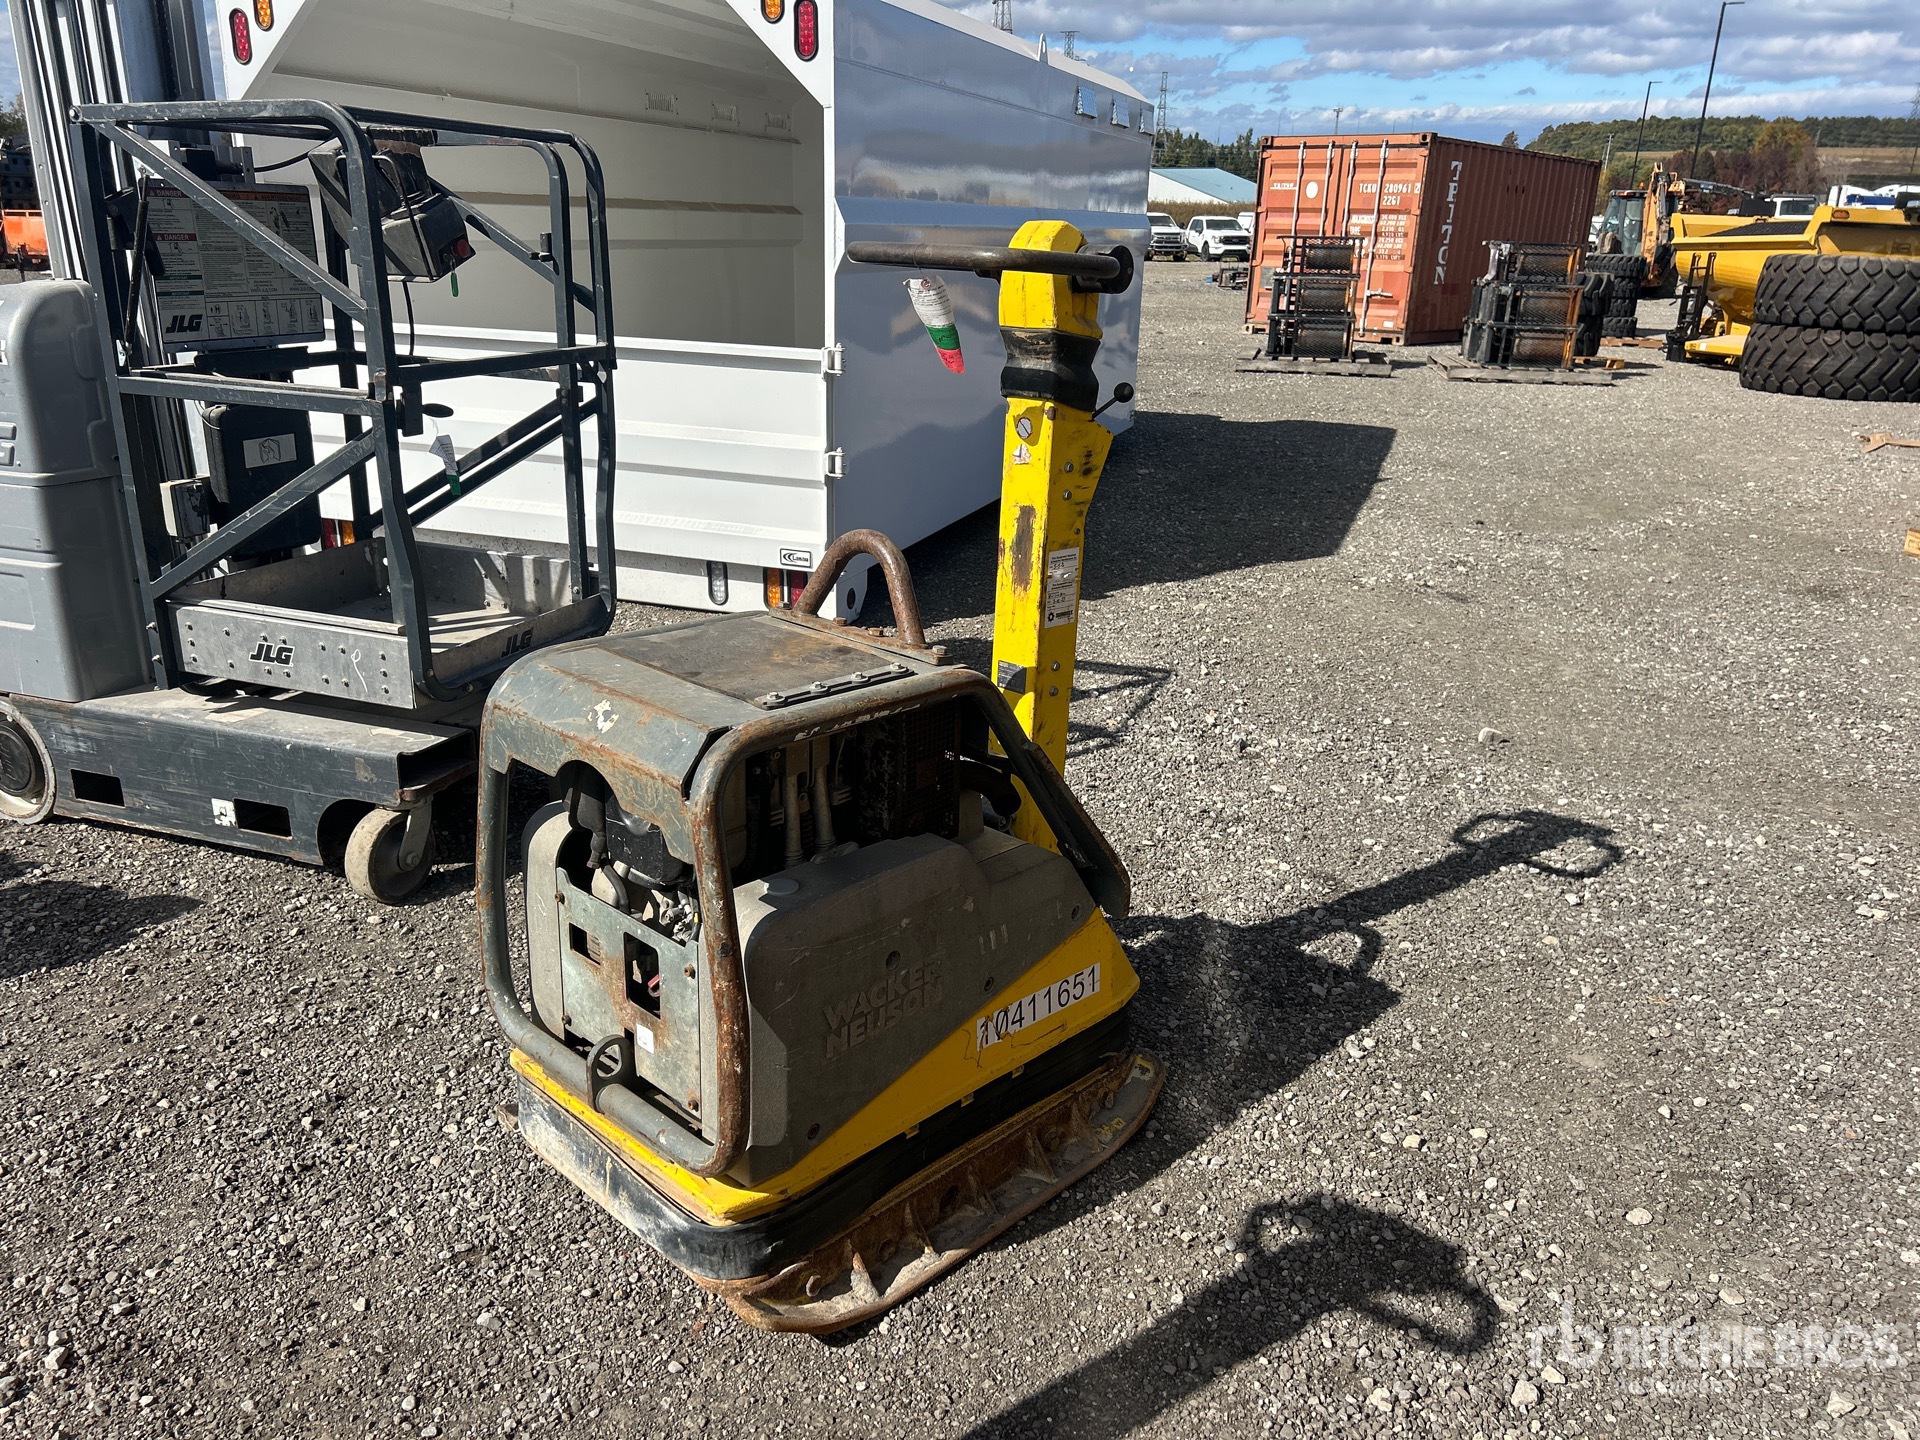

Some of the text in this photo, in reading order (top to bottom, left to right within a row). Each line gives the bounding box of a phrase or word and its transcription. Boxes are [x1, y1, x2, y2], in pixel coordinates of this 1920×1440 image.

[156, 189, 182, 198] DANGER
[1359, 183, 1377, 193] TCKU
[1384, 183, 1412, 193] 280961
[1433, 160, 1463, 285] TRITON
[164, 233, 190, 242] DANGER
[165, 314, 203, 333] JLG
[250, 643, 293, 665] JLG
[502, 630, 532, 656] JLG
[822, 961, 942, 1031] WACKER
[979, 965, 1096, 1045] 10411651
[825, 982, 942, 1060] NEUSON
